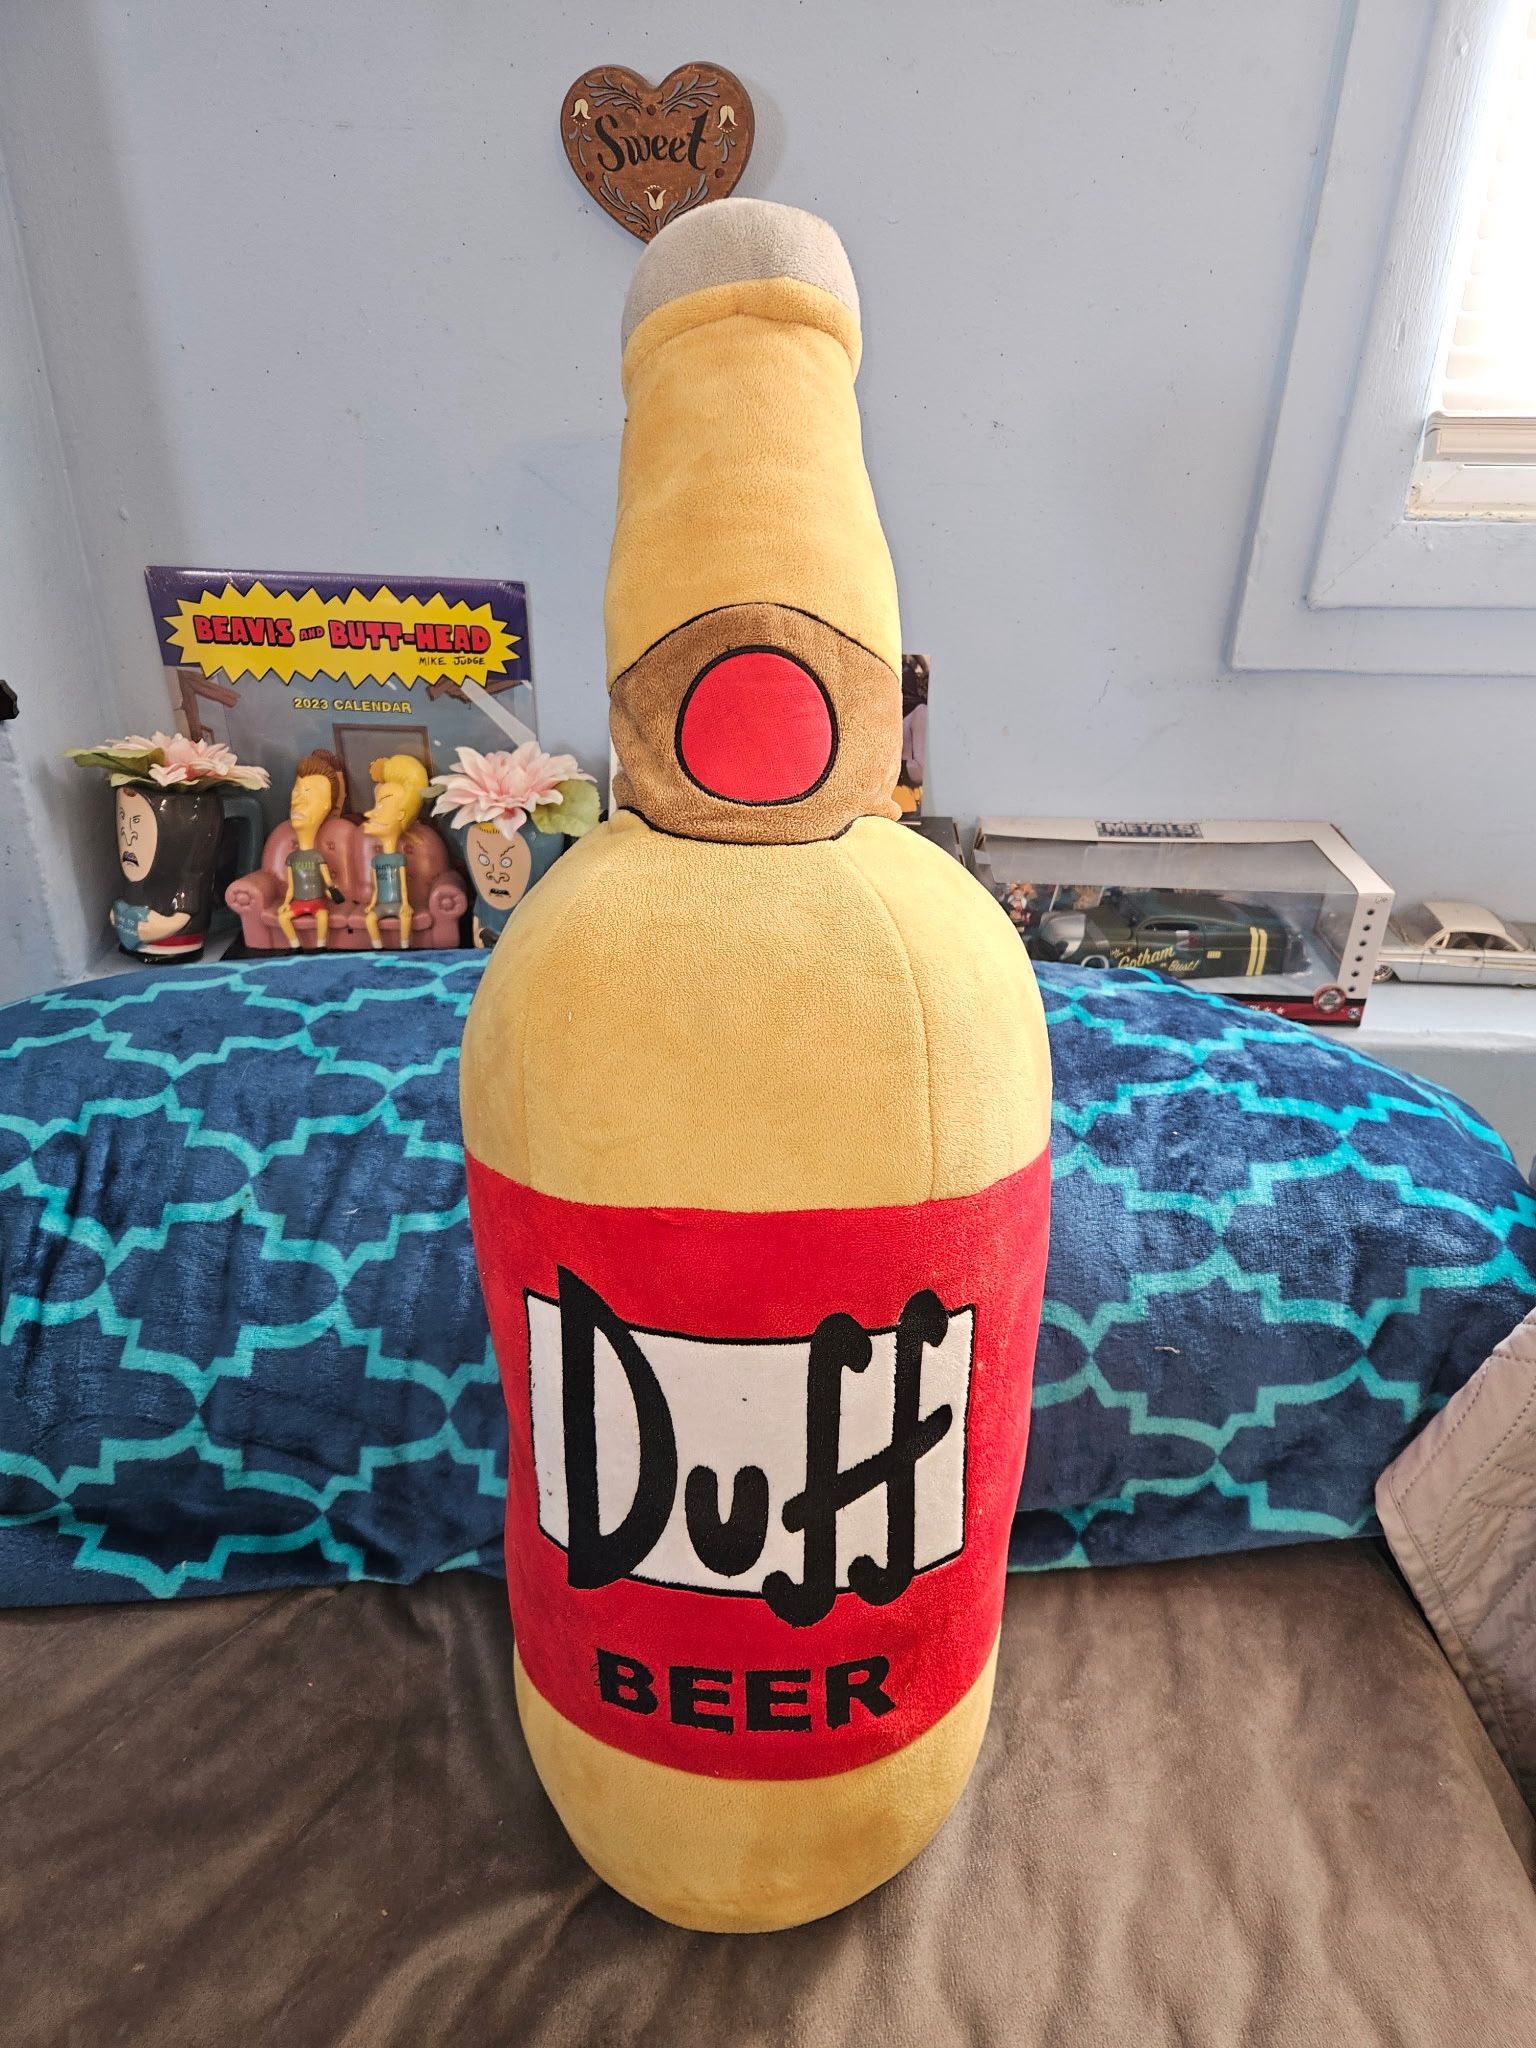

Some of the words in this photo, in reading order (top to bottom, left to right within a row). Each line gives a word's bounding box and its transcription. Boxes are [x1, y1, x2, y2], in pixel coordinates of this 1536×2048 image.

[594, 110, 709, 172] Sweet
[192, 615, 295, 647] BEAVIS
[299, 626, 325, 641] AND
[328, 619, 491, 653] BUTT-HEAD
[419, 655, 447, 667] MIKE
[453, 656, 486, 666] JUDGE
[294, 697, 329, 710] 2023
[334, 699, 412, 714] CALENDAR
[1101, 822, 1196, 834] METALS
[1118, 946, 1175, 969] Gotham
[557, 1264, 952, 1629] Duff
[596, 1648, 896, 1735] BEER
